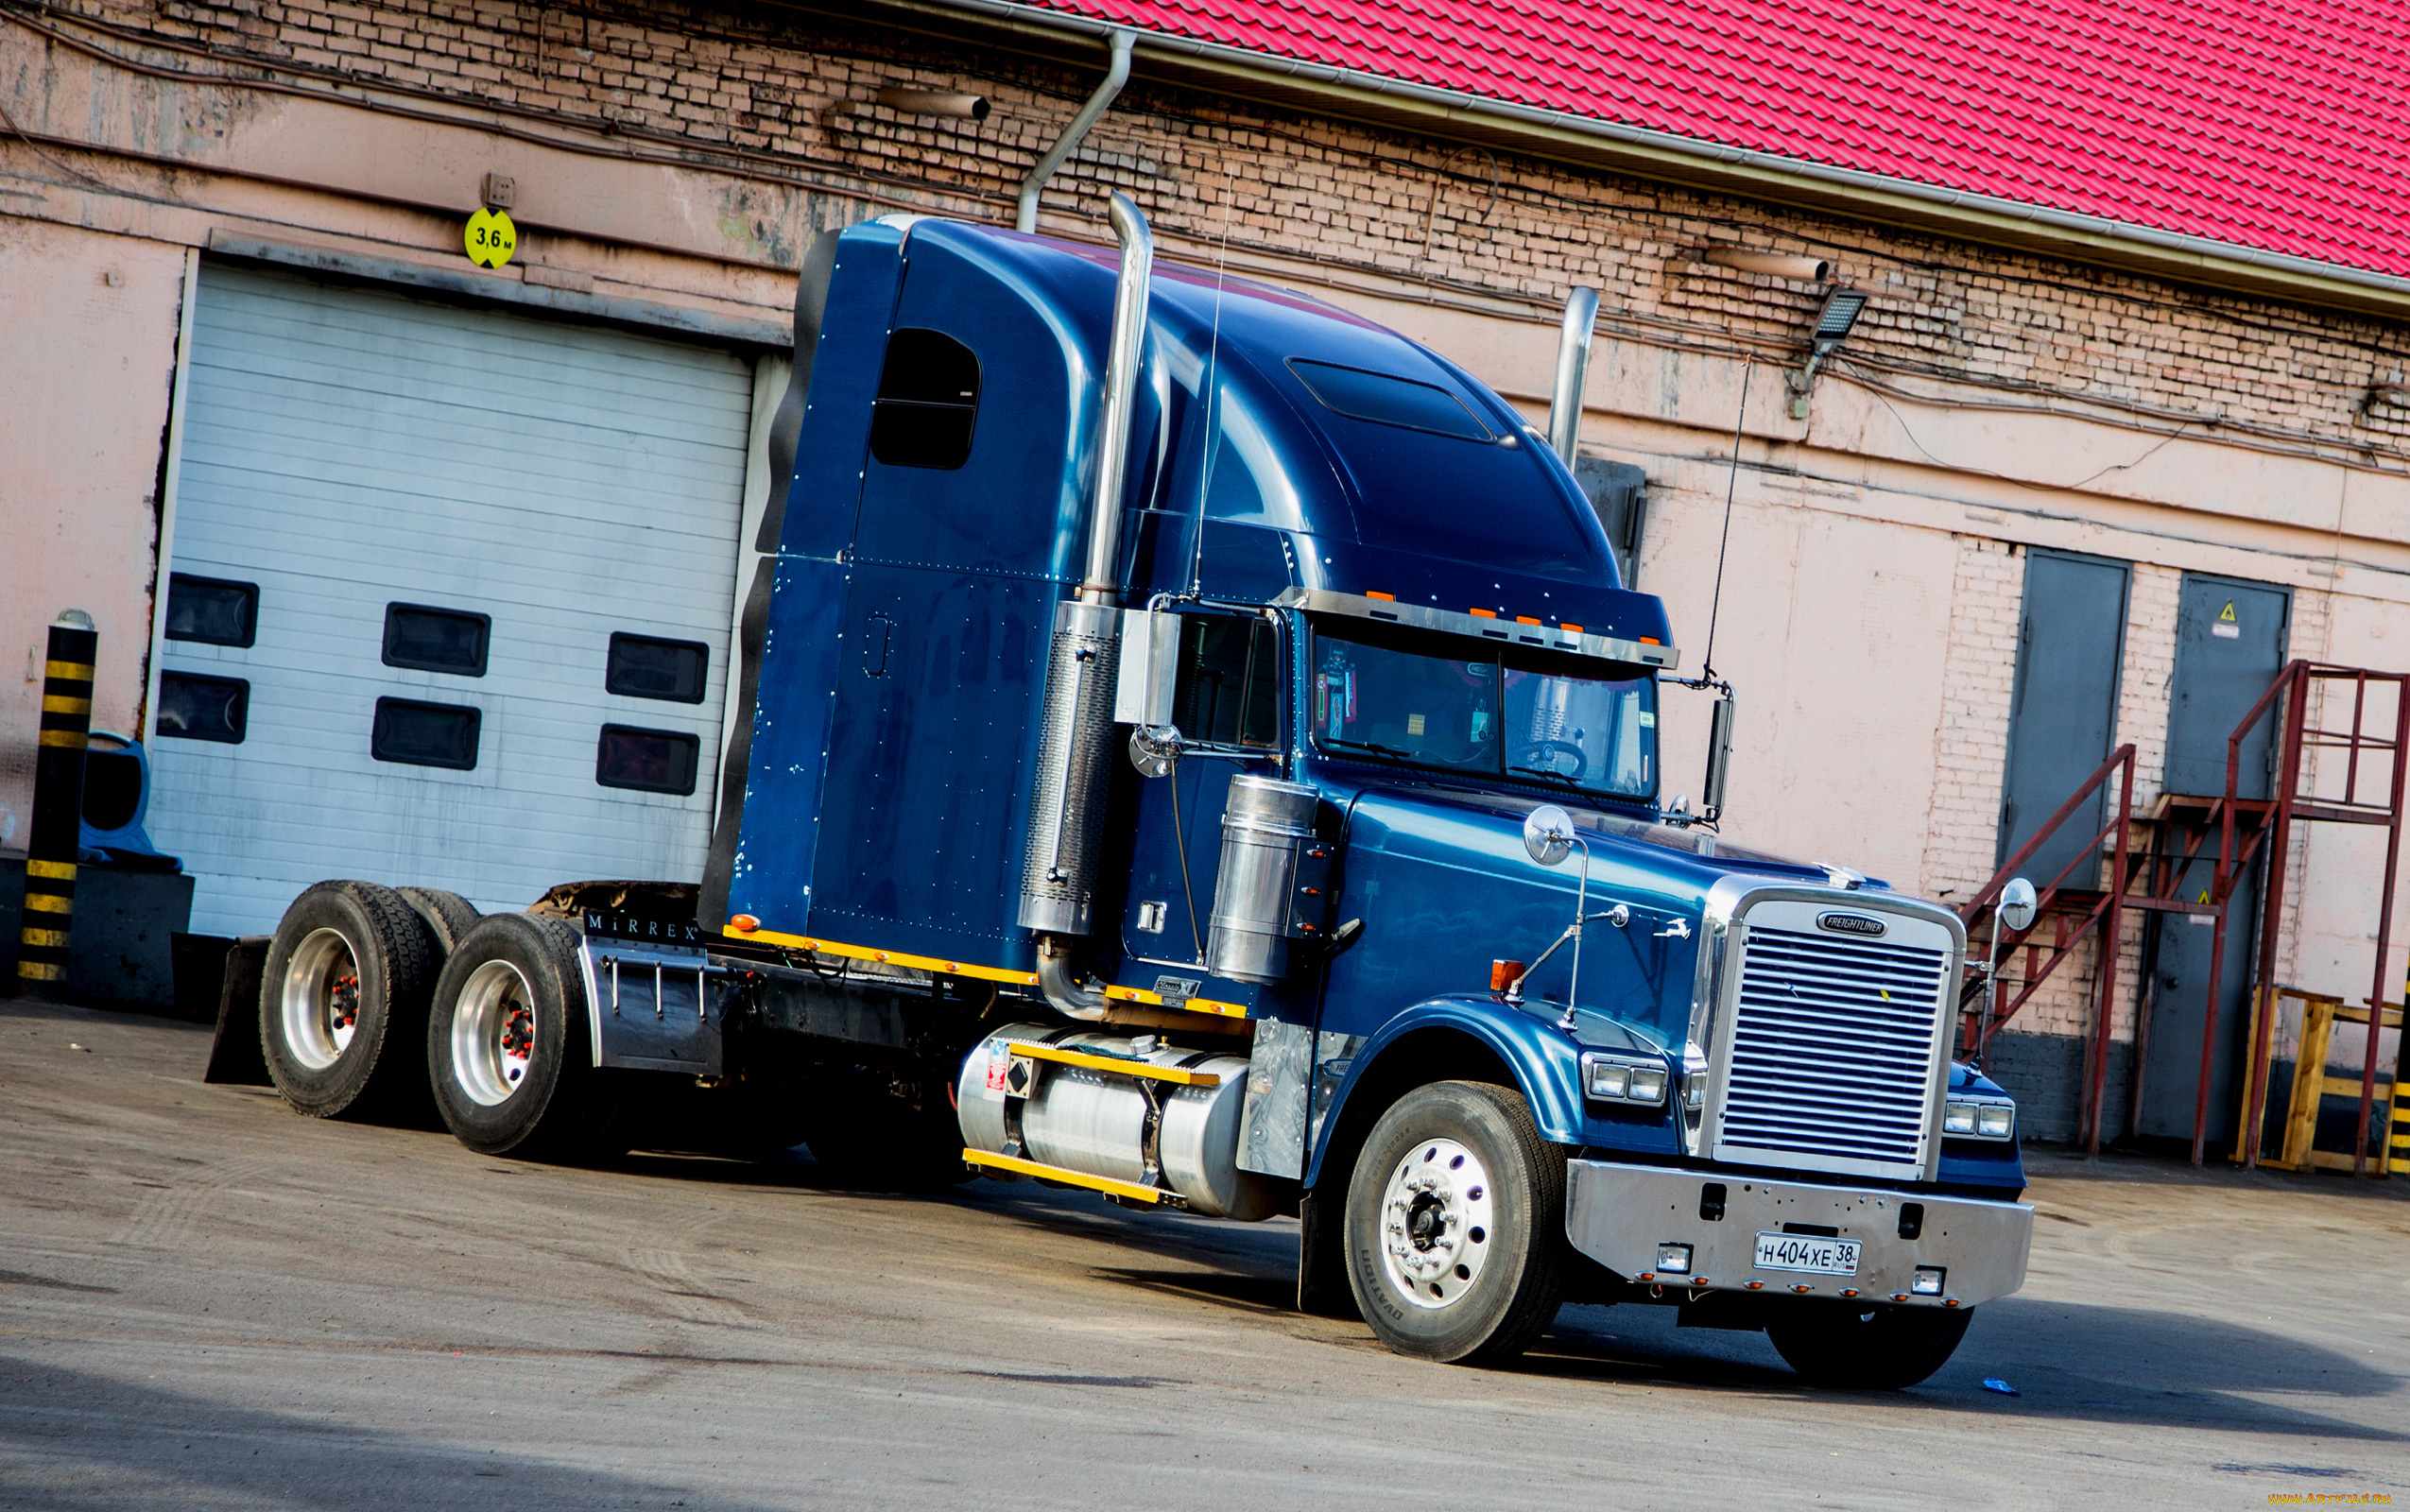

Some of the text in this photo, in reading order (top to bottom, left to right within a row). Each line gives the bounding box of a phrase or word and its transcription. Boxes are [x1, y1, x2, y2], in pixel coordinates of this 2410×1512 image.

[475, 227, 501, 249] 3,6
[1827, 917, 1883, 933] FREIGHTLINER
[1836, 1245, 1853, 1263] 38
[1833, 1262, 1846, 1270] RUS
[1361, 1248, 1404, 1321] OVATION
